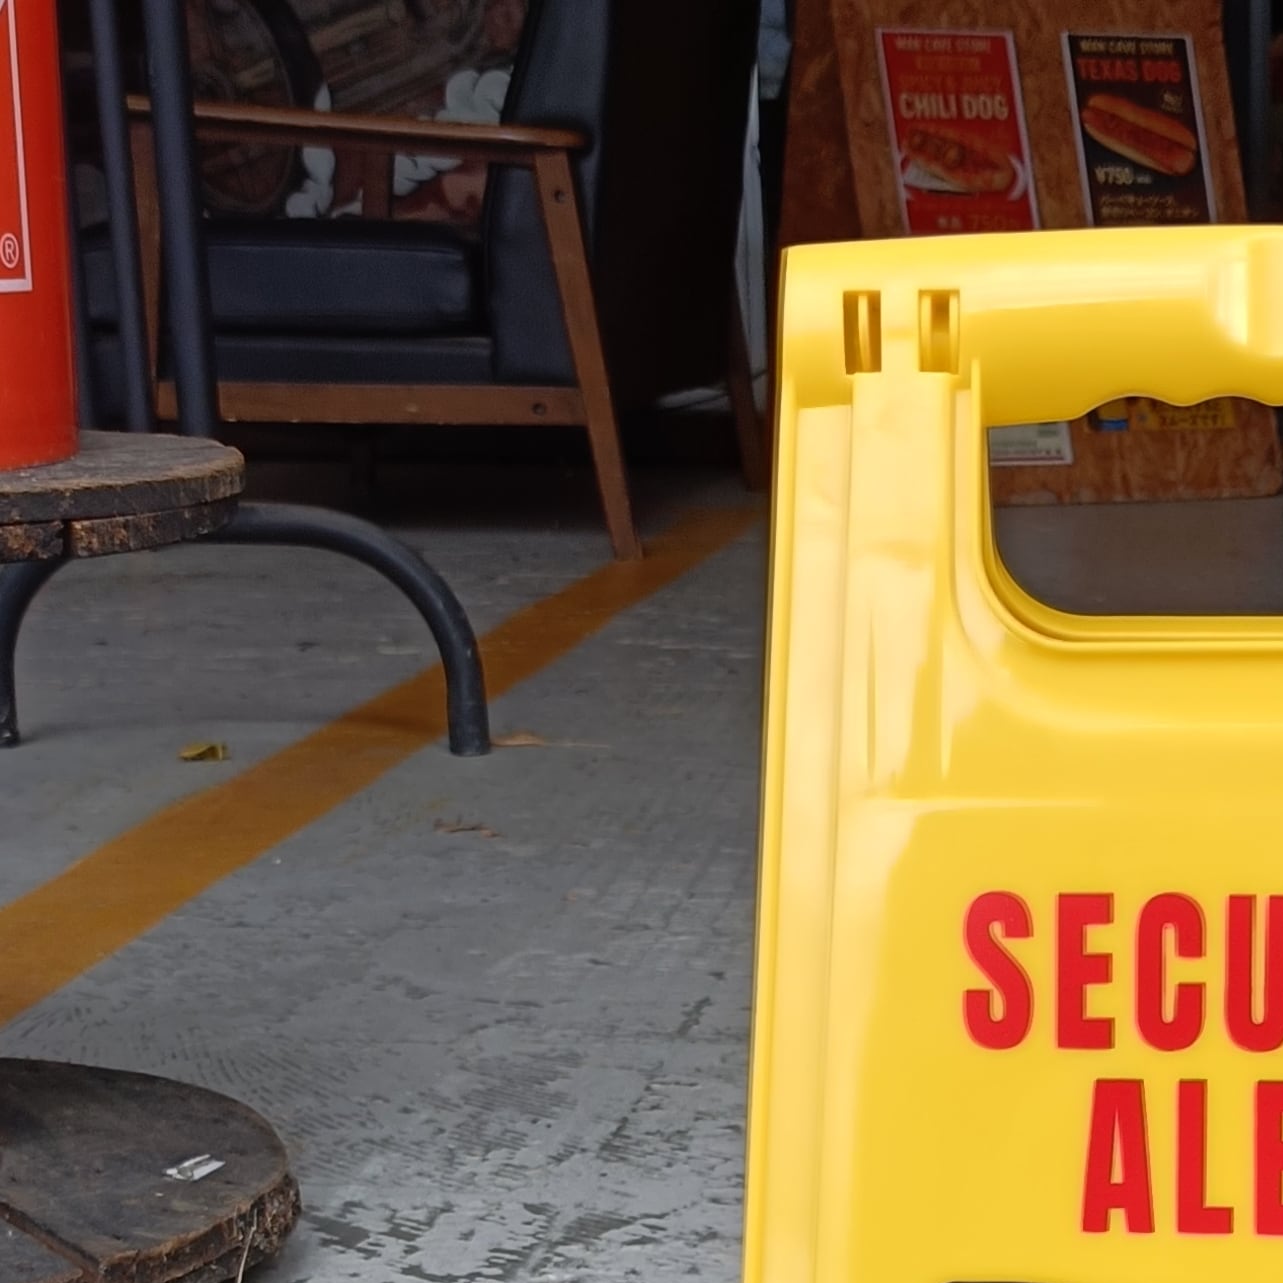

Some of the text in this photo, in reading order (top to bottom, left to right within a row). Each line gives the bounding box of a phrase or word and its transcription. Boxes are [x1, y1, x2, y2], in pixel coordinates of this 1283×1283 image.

[1076, 58, 1182, 83] TEXAS DOG
[900, 92, 1009, 121] CHILI DOG
